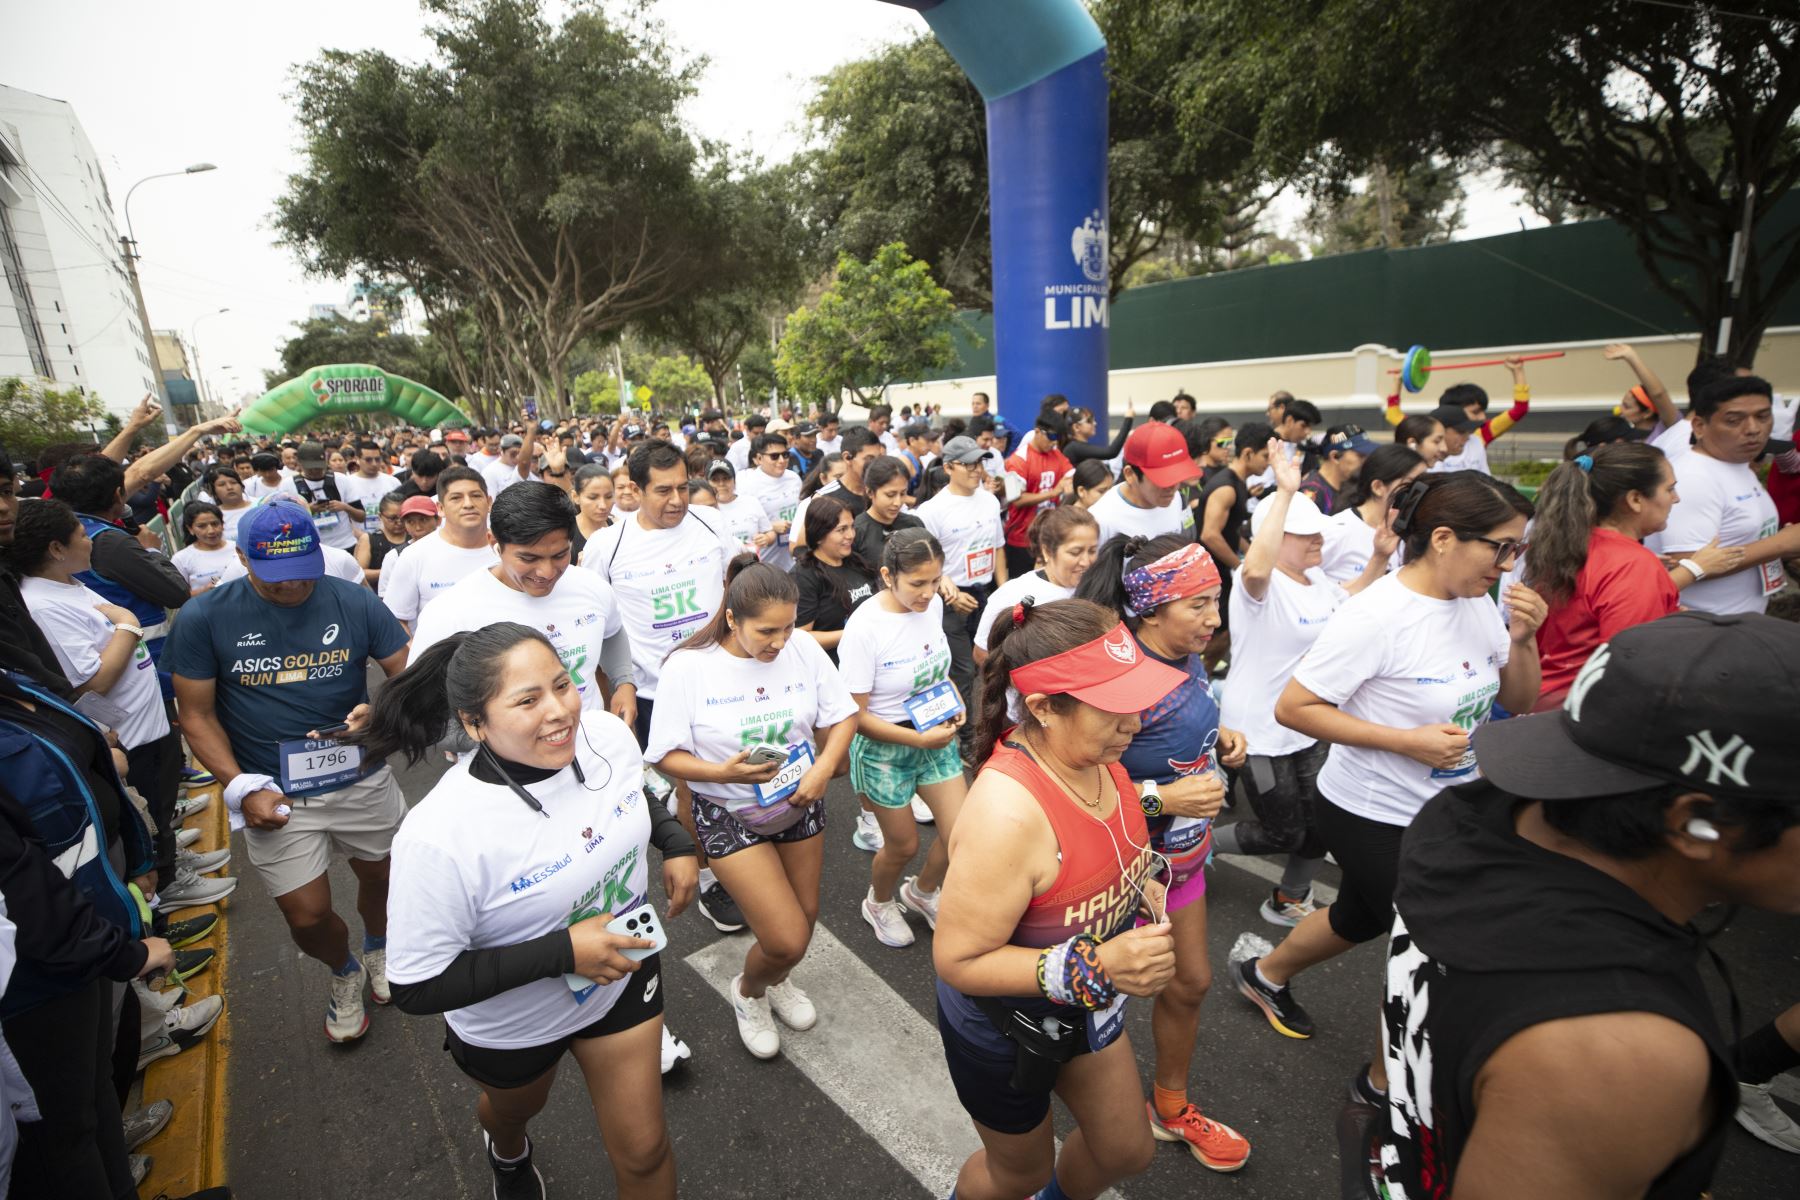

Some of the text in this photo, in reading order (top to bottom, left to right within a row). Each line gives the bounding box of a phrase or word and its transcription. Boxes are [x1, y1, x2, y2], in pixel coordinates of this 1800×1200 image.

[327, 376, 385, 393] SPORADE
[257, 535, 312, 550] RUNNING
[266, 543, 309, 556] FREELY
[651, 579, 696, 596] LIMA CORRE
[652, 587, 702, 621] 5K
[236, 639, 266, 648] RIMAC
[231, 648, 350, 673] ASICS GOLDEN
[913, 660, 929, 673] LIMA
[240, 664, 344, 686] RUN LIMA 2025
[755, 695, 770, 703] LIMA
[1458, 690, 1476, 707] LIMA
[740, 708, 794, 726] LIMA CORRE
[305, 751, 347, 771] 1796
[1680, 729, 1754, 787] NY
[772, 764, 803, 789] 2079
[623, 790, 638, 805] LIMA
[584, 834, 605, 854] LIMA
[533, 853, 573, 883] EsSalud
[572, 880, 601, 911] LIMA
[603, 844, 639, 884] CORRE
